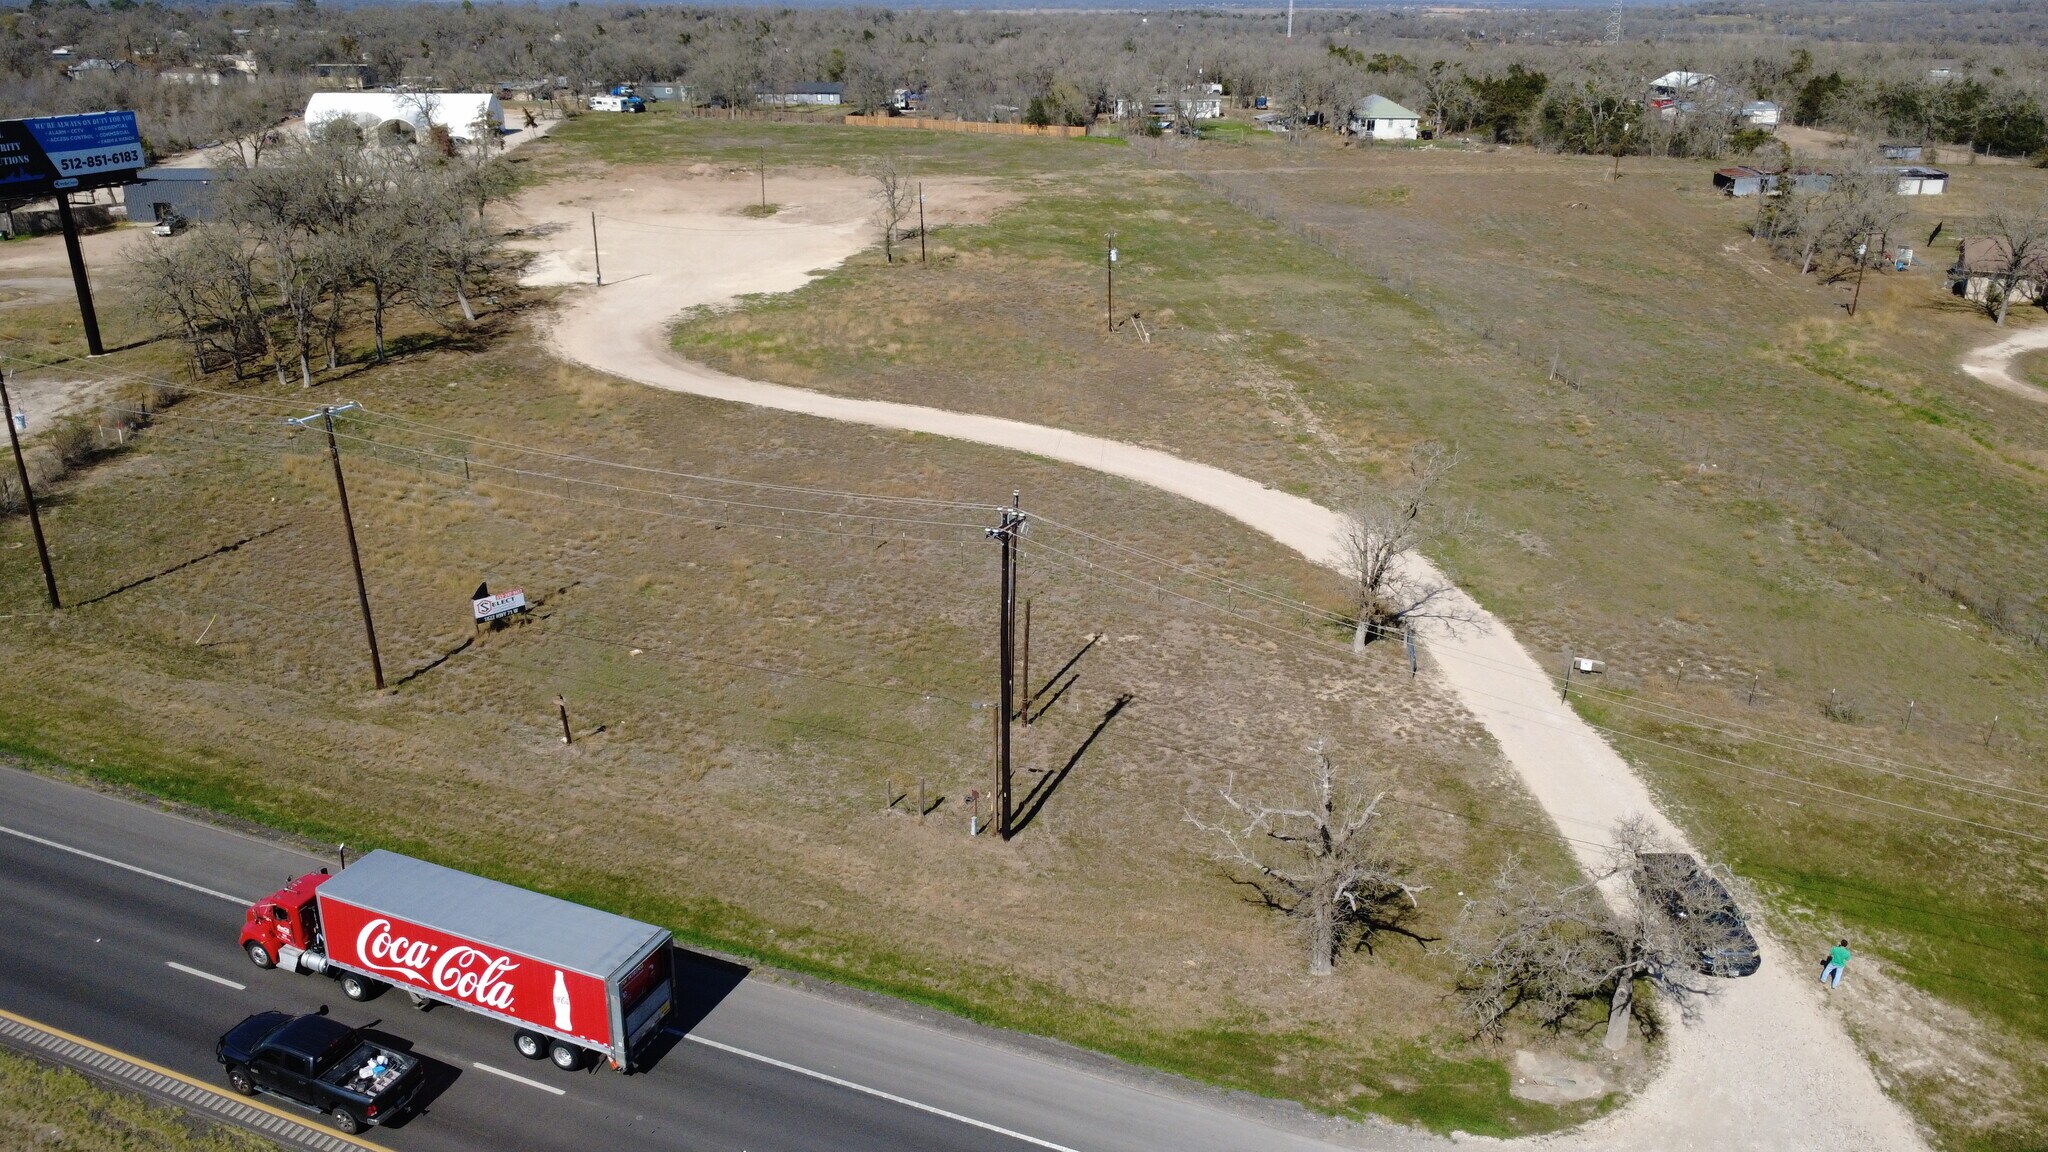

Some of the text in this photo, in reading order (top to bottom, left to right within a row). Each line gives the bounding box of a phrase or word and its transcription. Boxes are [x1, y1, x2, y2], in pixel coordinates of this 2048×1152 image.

[56, 120, 81, 128] ALWAYS
[109, 116, 120, 124] FOR
[100, 130, 130, 138] COMMERCIAL
[61, 150, 139, 171] 512-851-6183
[356, 918, 520, 1010] Coca-Cola
